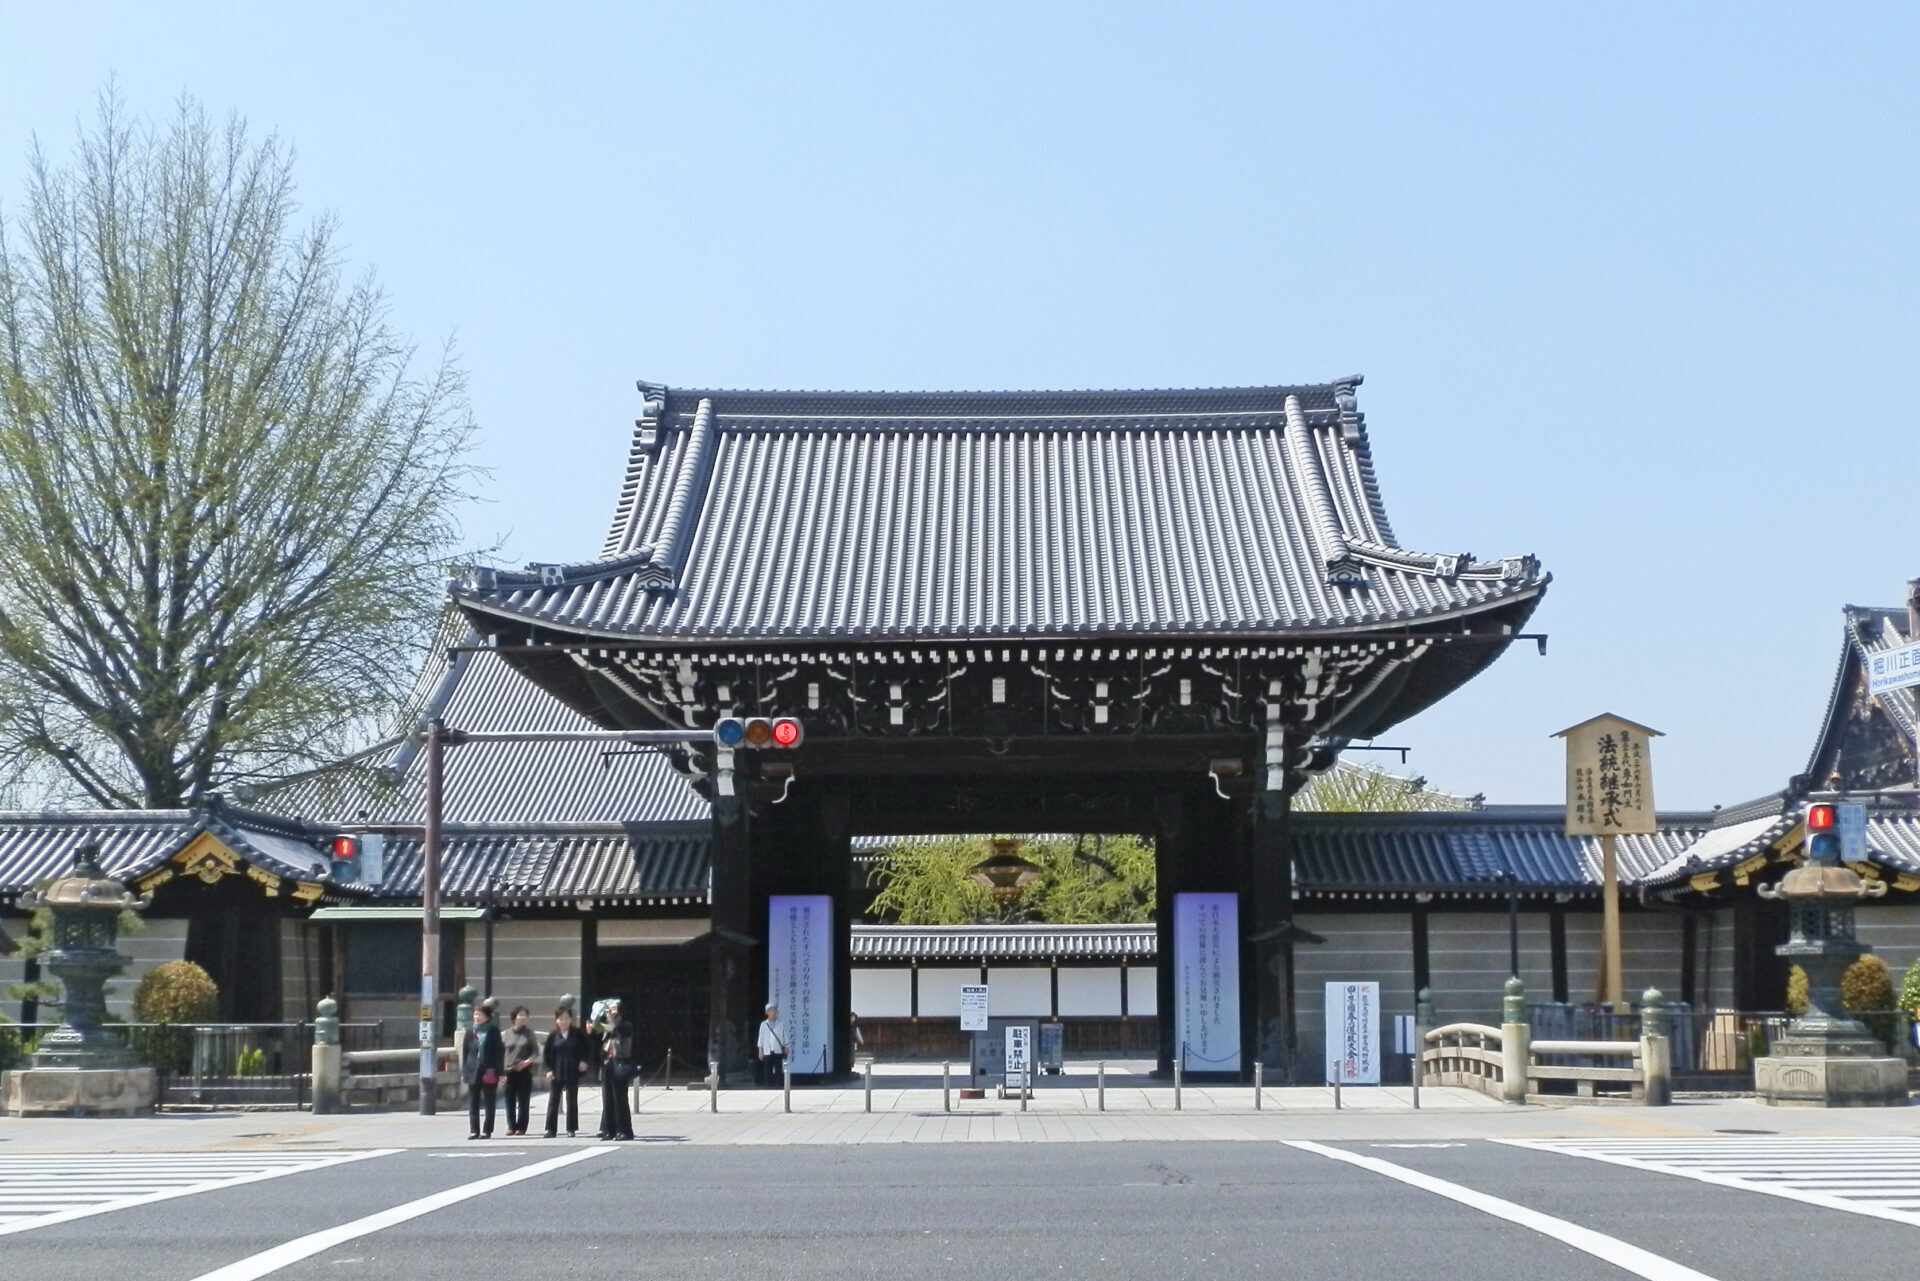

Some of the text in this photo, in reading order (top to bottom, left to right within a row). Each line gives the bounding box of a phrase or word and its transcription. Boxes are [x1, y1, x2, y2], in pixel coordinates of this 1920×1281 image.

[1598, 733, 1623, 828] 法統継承式
[1013, 1028, 1023, 1069] 駐車禁止
